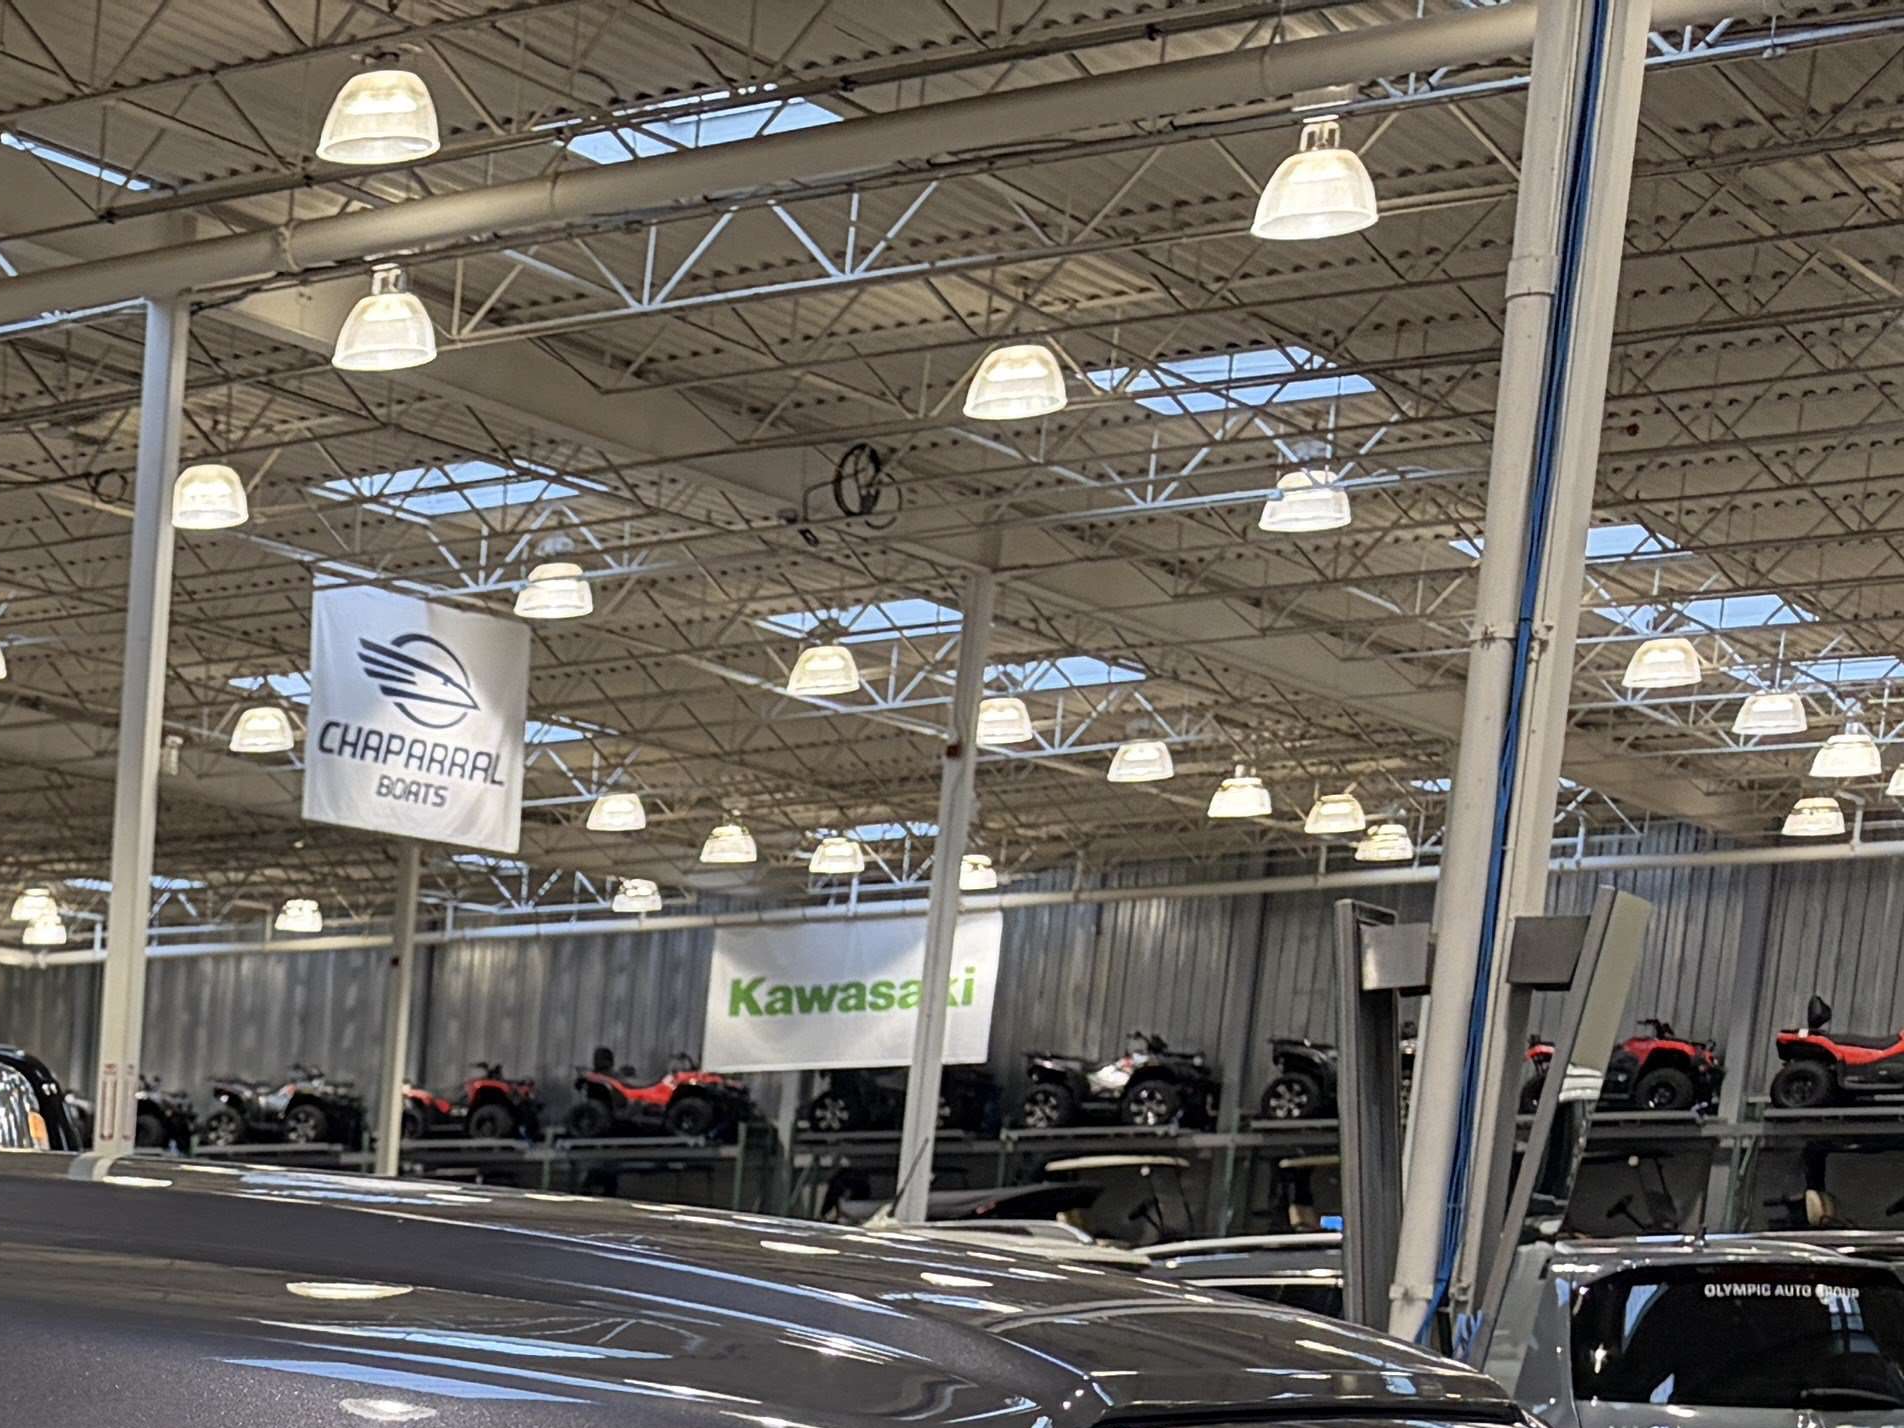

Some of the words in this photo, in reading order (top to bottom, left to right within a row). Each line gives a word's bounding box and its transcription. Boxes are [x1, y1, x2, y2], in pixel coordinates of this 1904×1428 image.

[318, 719, 505, 787] CHAPARRAL
[376, 773, 449, 808] BOATS
[1703, 1282, 1772, 1298] OLYMPIC
[1774, 1283, 1813, 1298] AUTO
